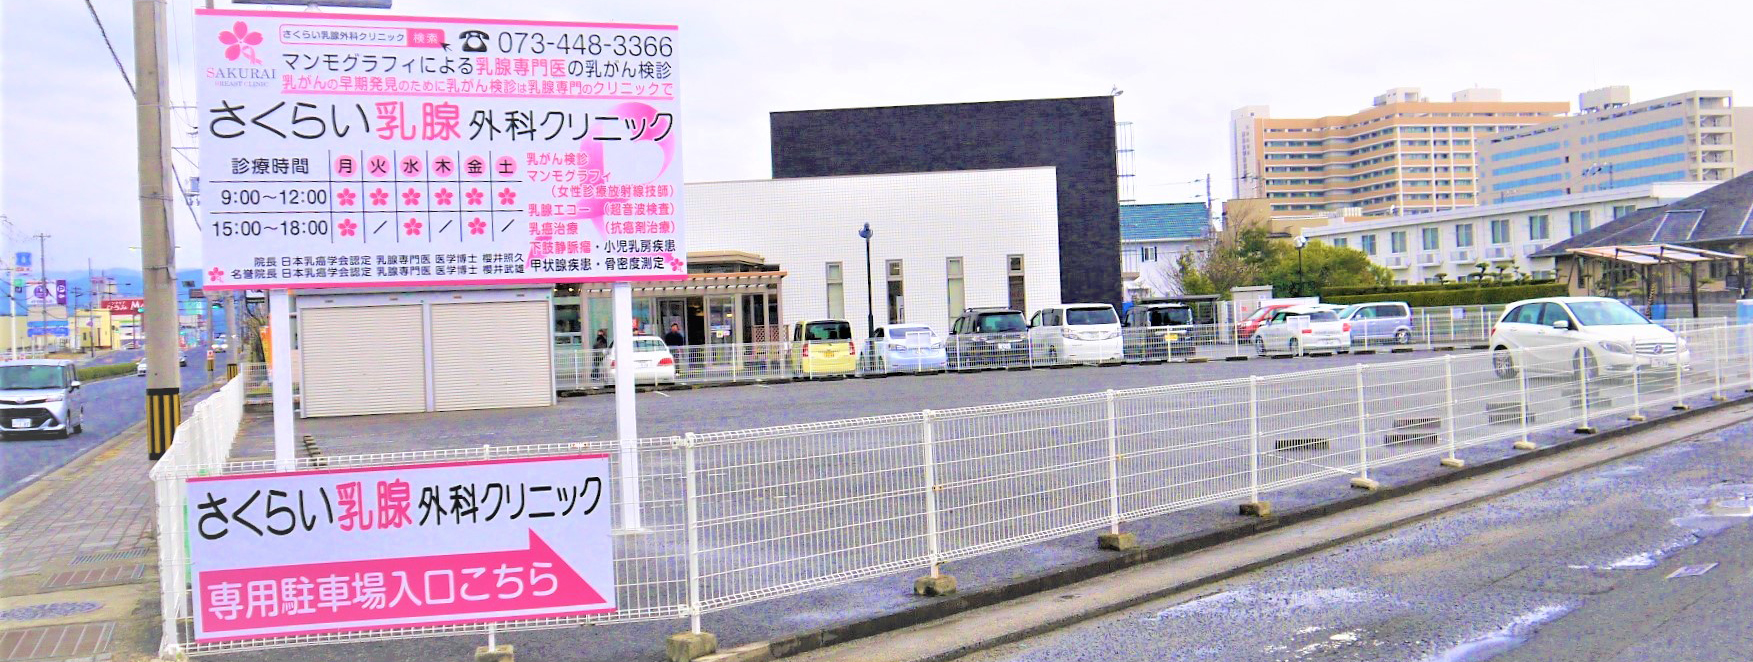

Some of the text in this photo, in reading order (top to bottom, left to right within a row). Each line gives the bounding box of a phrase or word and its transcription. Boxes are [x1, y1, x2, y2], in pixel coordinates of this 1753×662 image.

[282, 30, 439, 43] さくらい乳腺外科クリニック 検索
[498, 31, 673, 57] 073-448-3366
[206, 67, 276, 79] SAKURAI
[231, 157, 309, 174] 診療時間
[338, 158, 514, 174] 月 火 水 木 金 土
[526, 152, 588, 166] 乳がん検診
[527, 170, 611, 183] マンモグラフィ
[528, 203, 590, 217] 乳腺エコー
[528, 222, 579, 236] 乳癌治療
[254, 256, 277, 267] 院長
[207, 561, 559, 621] 専用駐車場入口こちら
